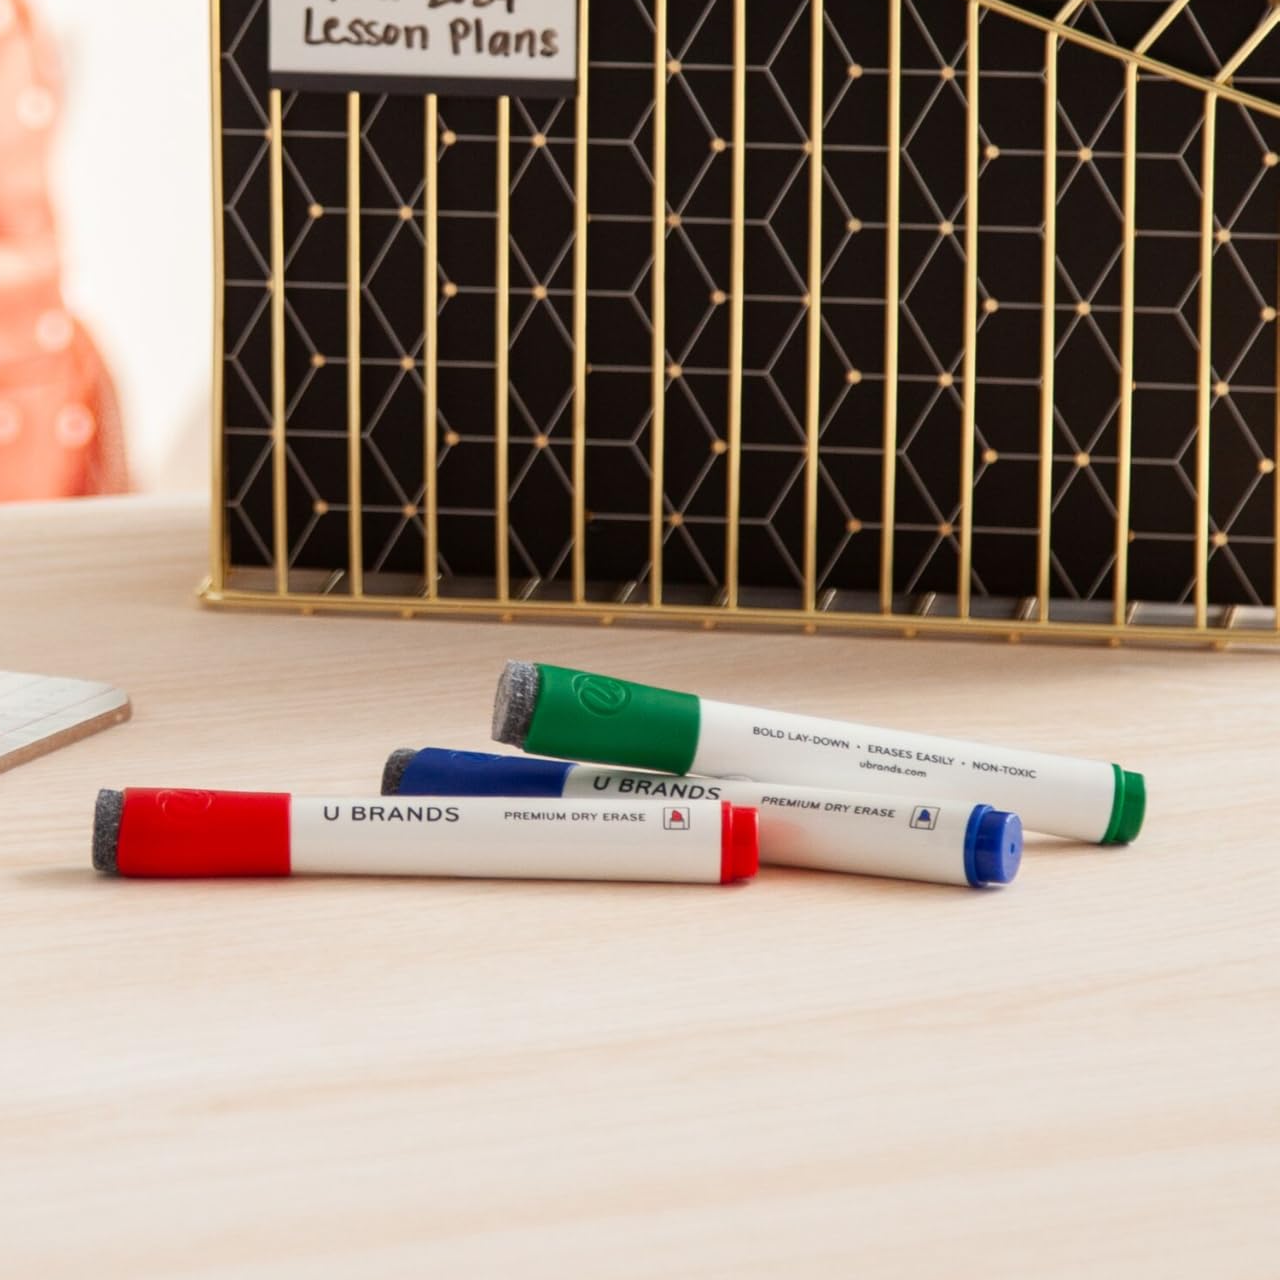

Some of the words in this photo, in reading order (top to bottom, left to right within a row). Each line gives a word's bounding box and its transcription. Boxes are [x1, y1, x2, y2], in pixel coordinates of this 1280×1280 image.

[304, 7, 429, 51] Lesson
[448, 17, 560, 58] Plans
[752, 725, 786, 740] BOLD
[787, 731, 851, 751] LAY-DOWN
[867, 743, 914, 760] ERASES
[915, 752, 956, 766] EASILY
[971, 759, 1038, 780] NON-TOXIC
[858, 759, 928, 779] ubrands.com
[593, 775, 610, 791] U
[618, 776, 721, 801] BRANDS
[323, 805, 340, 822] U
[351, 805, 461, 823] BRANDS
[503, 810, 567, 822] PREMIUM
[570, 811, 599, 822] DRY
[602, 811, 647, 823] ERASE
[760, 795, 820, 811] PREMIUM
[823, 801, 850, 813] DRY
[853, 805, 896, 819] ERASE
